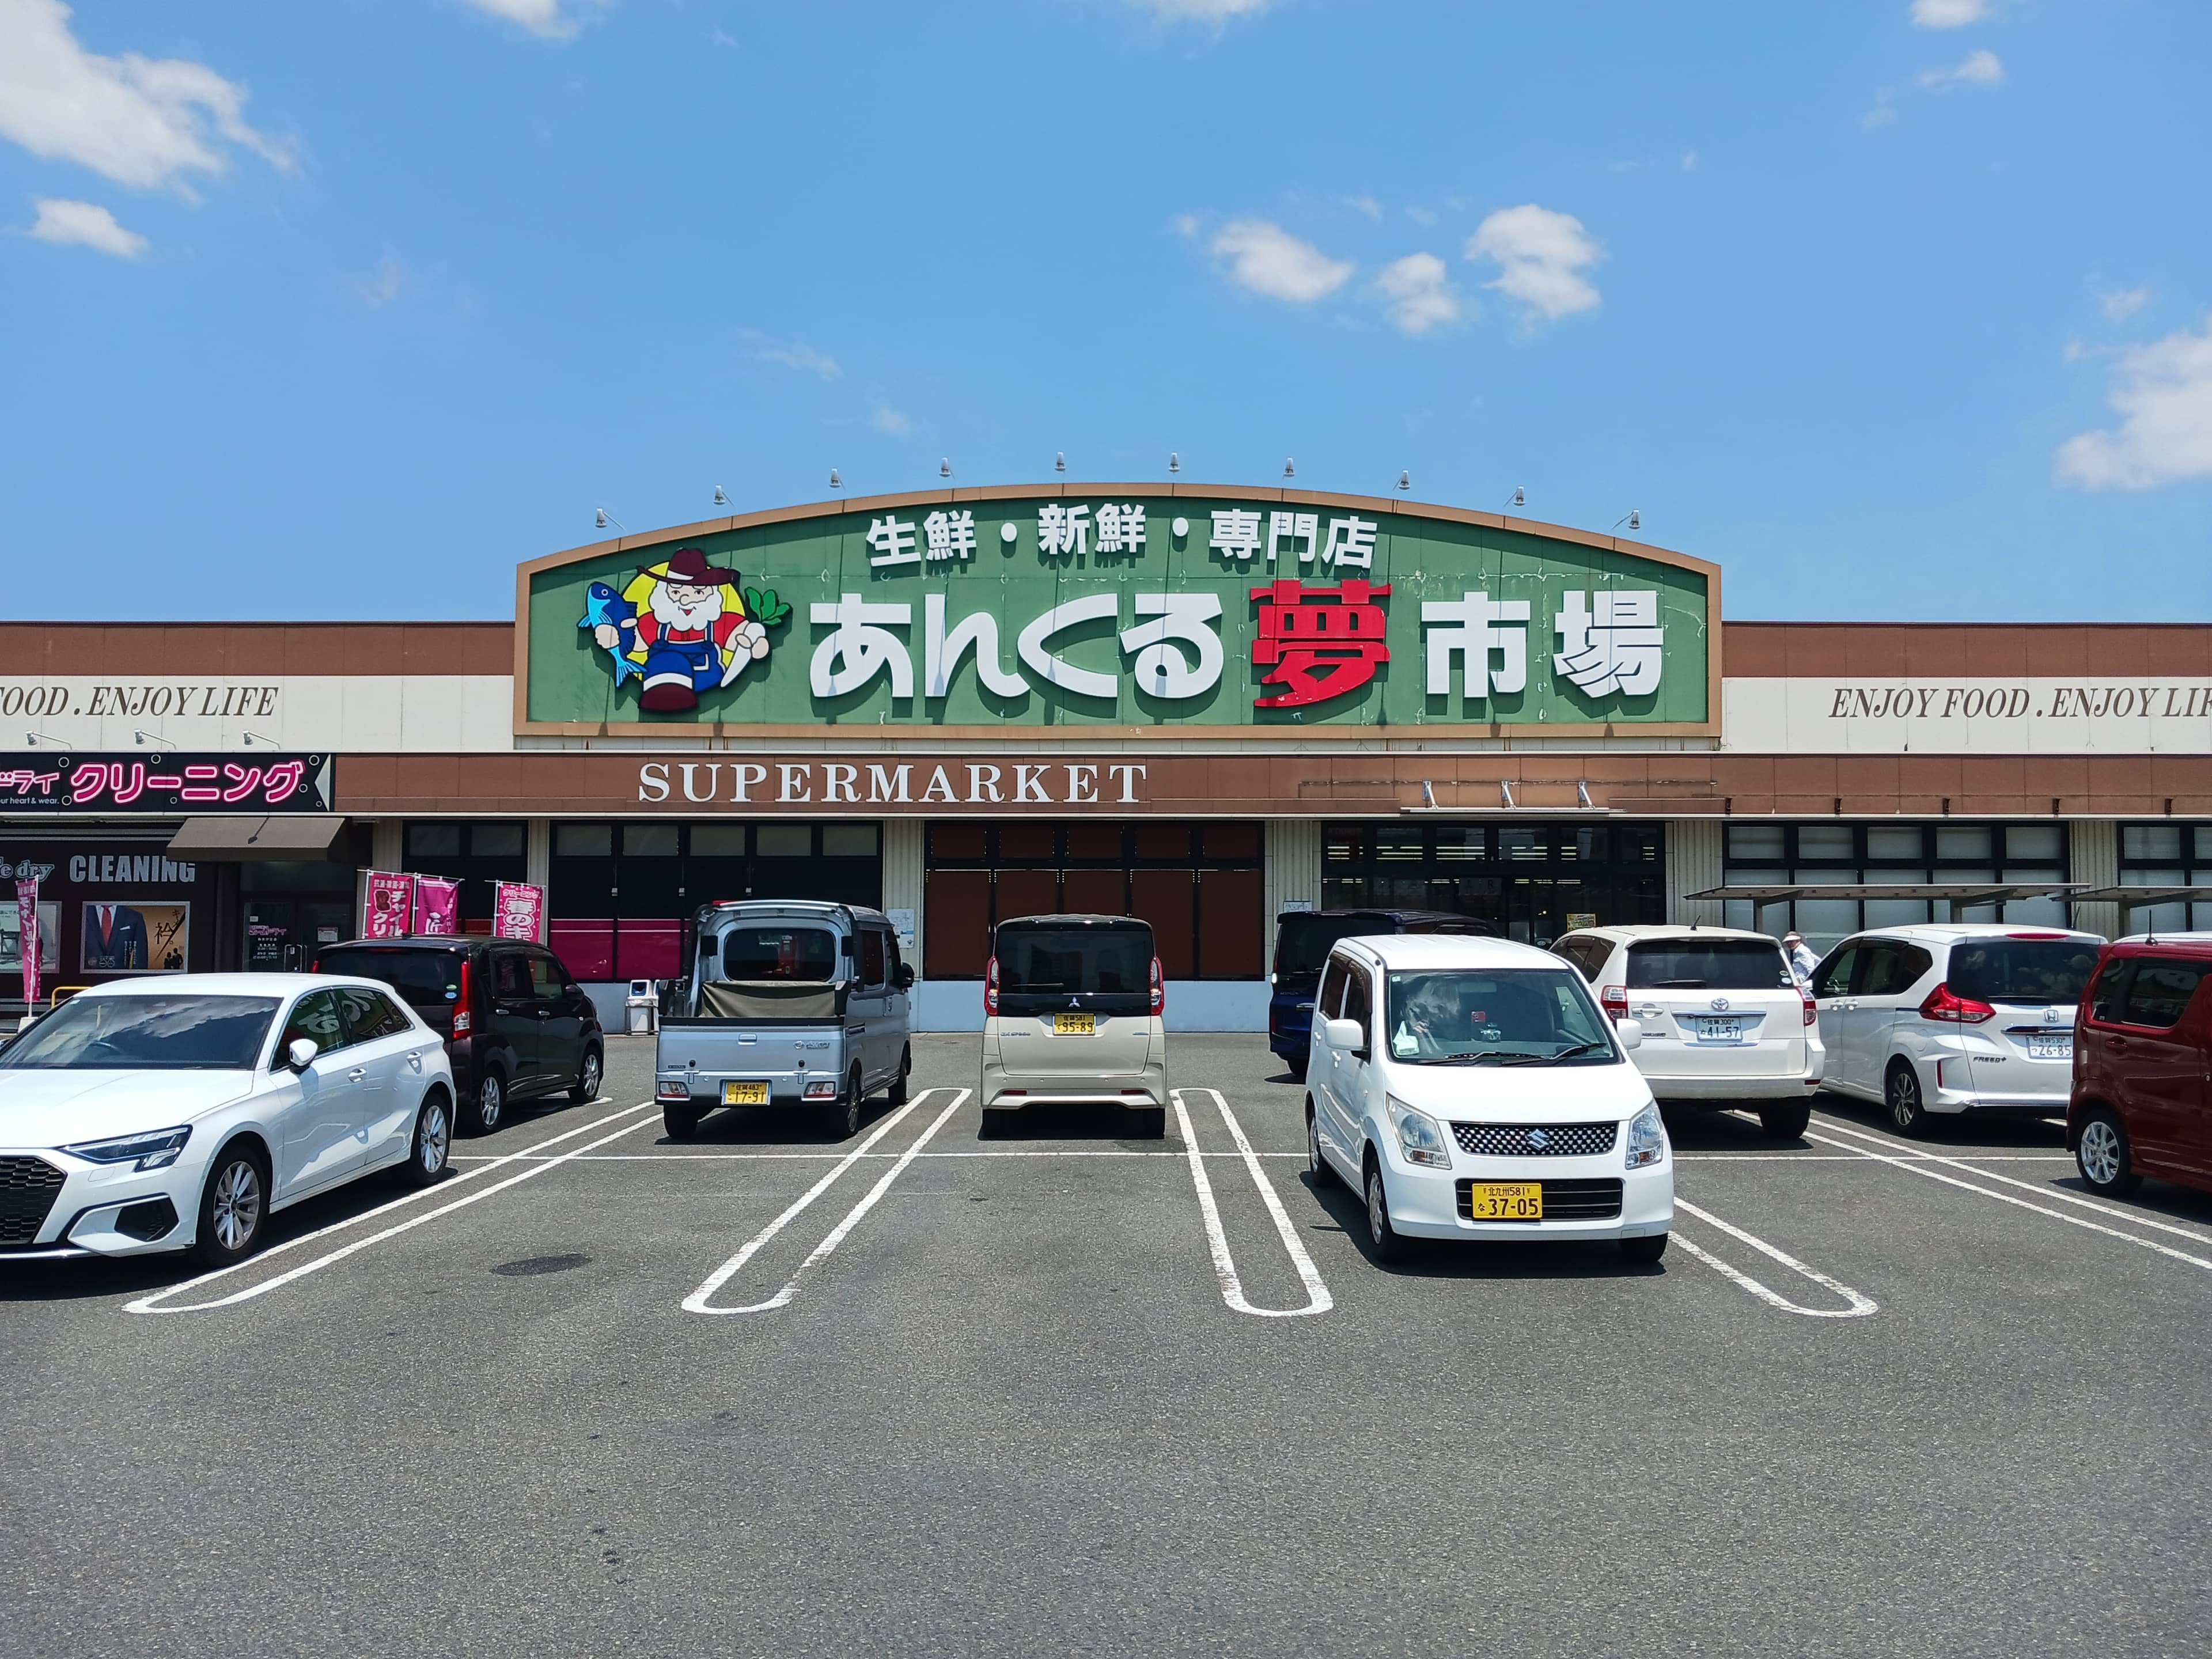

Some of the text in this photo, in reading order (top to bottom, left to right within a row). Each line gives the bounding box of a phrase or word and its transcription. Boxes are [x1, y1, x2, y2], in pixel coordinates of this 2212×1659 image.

[85, 687, 199, 716] ENJOY
[197, 687, 279, 716] LIFE
[1828, 688, 1939, 717] ENJOY
[2047, 688, 2160, 717] ENJOY
[70, 760, 305, 804] クリーニング
[638, 762, 1146, 802] SUPERMARKET
[15, 859, 55, 882] dry
[69, 855, 195, 882] CLEANING
[1062, 1022, 1093, 1032] 95-89
[1707, 1027, 1739, 1038] 41-57
[2039, 1044, 2071, 1056] 26-85
[735, 1091, 764, 1103] 17-91
[1488, 1186, 1525, 1196] 北九州581
[1488, 1198, 1539, 1216] 37-05
